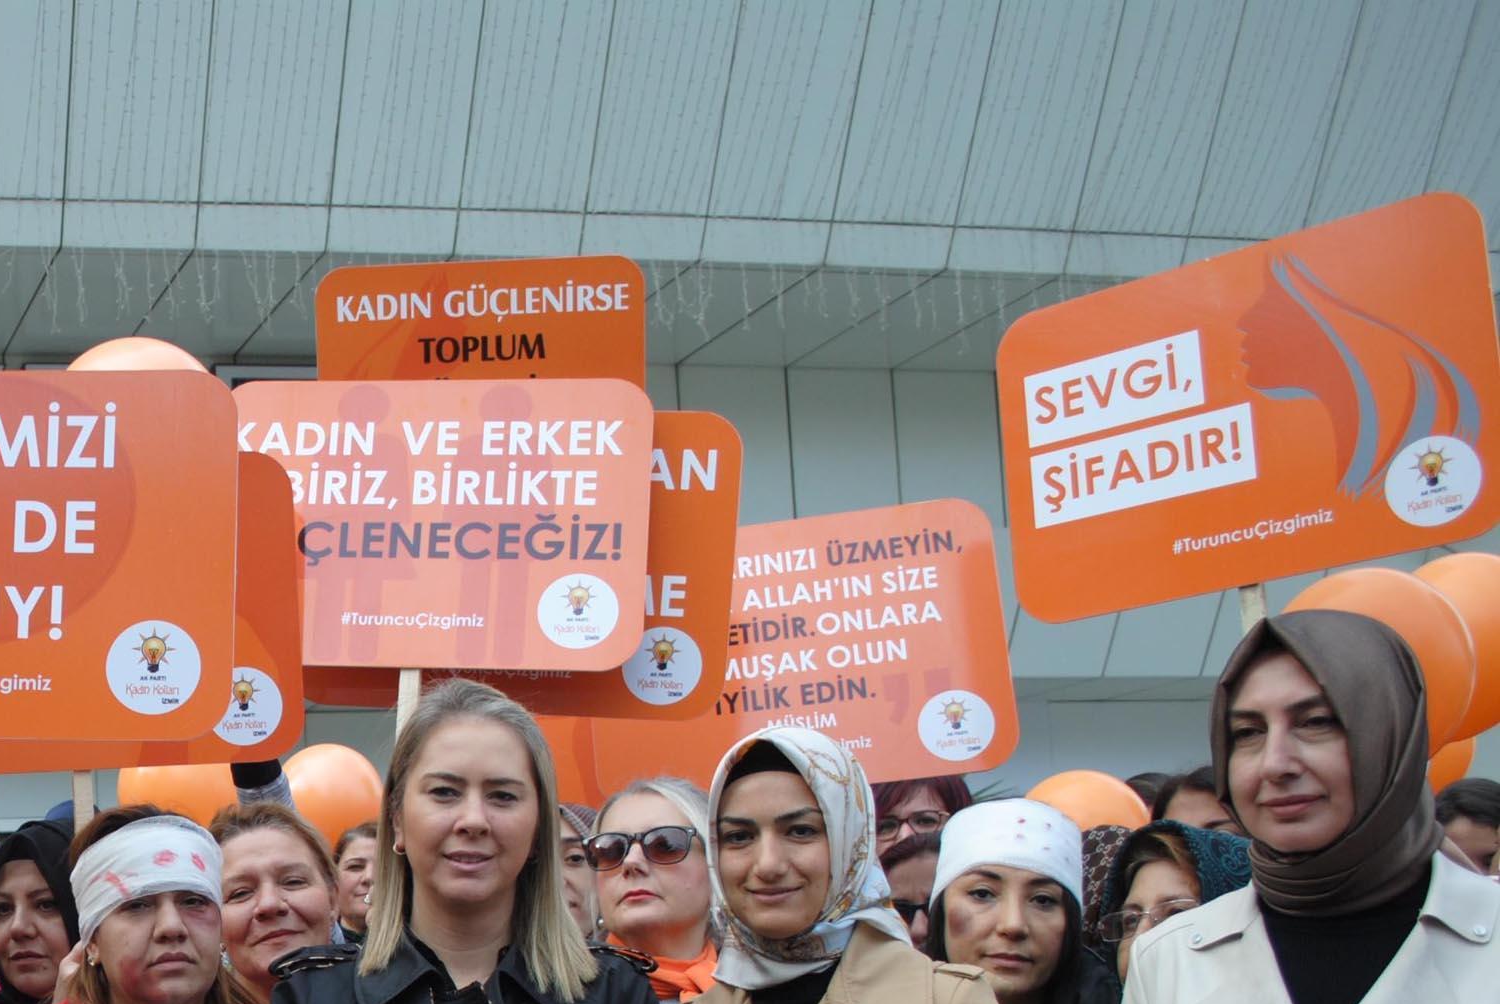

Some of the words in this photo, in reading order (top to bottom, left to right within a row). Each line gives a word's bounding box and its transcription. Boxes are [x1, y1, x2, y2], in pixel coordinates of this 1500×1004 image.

[337, 293, 431, 322] KADIN
[444, 280, 628, 322] GÜÇLENİRSE
[419, 334, 545, 363] TOPLUM
[1034, 342, 1193, 427] SEVGİ,
[238, 422, 375, 456] KADIN
[402, 421, 460, 455] VE
[482, 421, 622, 455] ERKEK
[413, 462, 597, 505] BİRLİKTE
[650, 448, 719, 492] AN
[1043, 420, 1243, 513] ŞİFADIR!
[13, 500, 97, 554] DE
[297, 513, 622, 566] ÇLENECEĞİZ!
[827, 528, 962, 566] ÜZMEYİN,
[1173, 509, 1333, 554] #TuruncuÇizgimiz
[743, 575, 872, 611] ALLAH'IN
[882, 566, 938, 593] SİZE
[342, 612, 483, 630] #TuruncuÇizgimiz
[827, 639, 907, 667] OLUN
[801, 675, 876, 705] EDİN.
